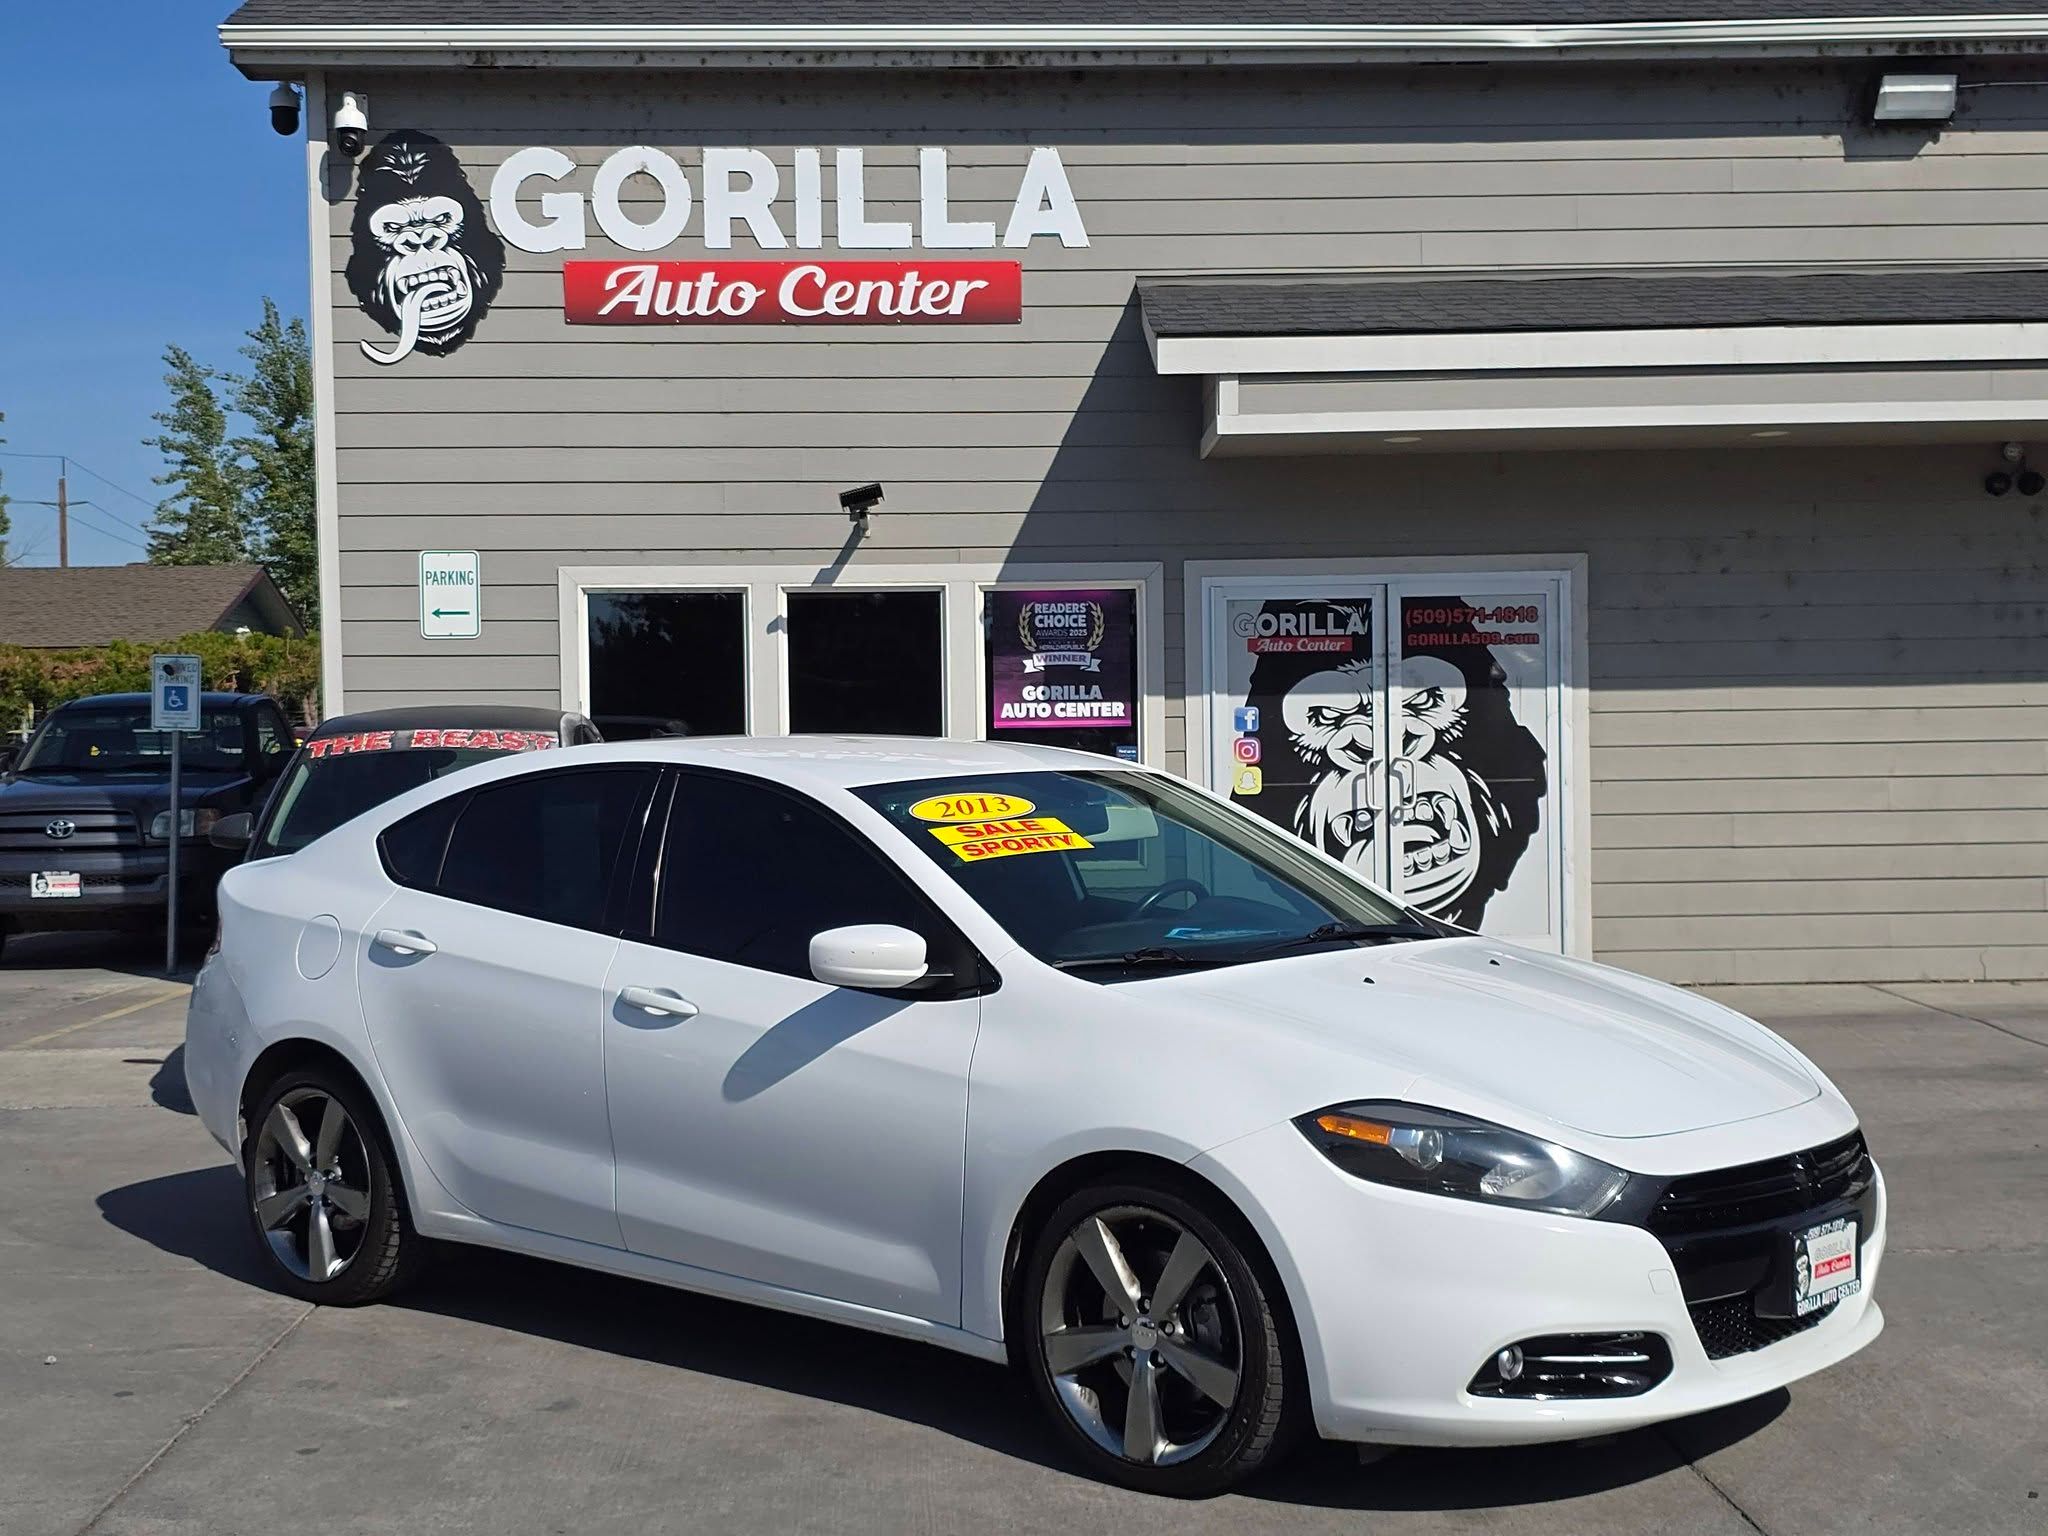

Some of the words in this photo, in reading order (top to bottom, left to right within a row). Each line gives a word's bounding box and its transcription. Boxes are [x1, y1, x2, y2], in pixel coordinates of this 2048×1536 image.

[490, 146, 1090, 253] GORILLA
[599, 265, 766, 316] Auto
[778, 265, 989, 317] Center
[425, 570, 474, 585] PARKING
[1034, 614, 1087, 628] CHOICE
[1233, 612, 1366, 638] GORILLA
[1035, 629, 1068, 637] AWARDS
[1257, 638, 1293, 652] Auto
[1297, 638, 1345, 652] Center
[1036, 653, 1088, 663] WINNER
[159, 674, 194, 685] PARKING
[1022, 685, 1103, 701] GORILLA
[1001, 702, 1052, 719] AUTO
[1054, 702, 1125, 718] CENTER
[306, 731, 395, 759] THE
[411, 729, 560, 751] BEAST
[935, 796, 1011, 818] 2013
[956, 820, 1046, 838] SALE
[961, 834, 1074, 858] SPORTY
[1822, 1289, 1838, 1306] AUTO
